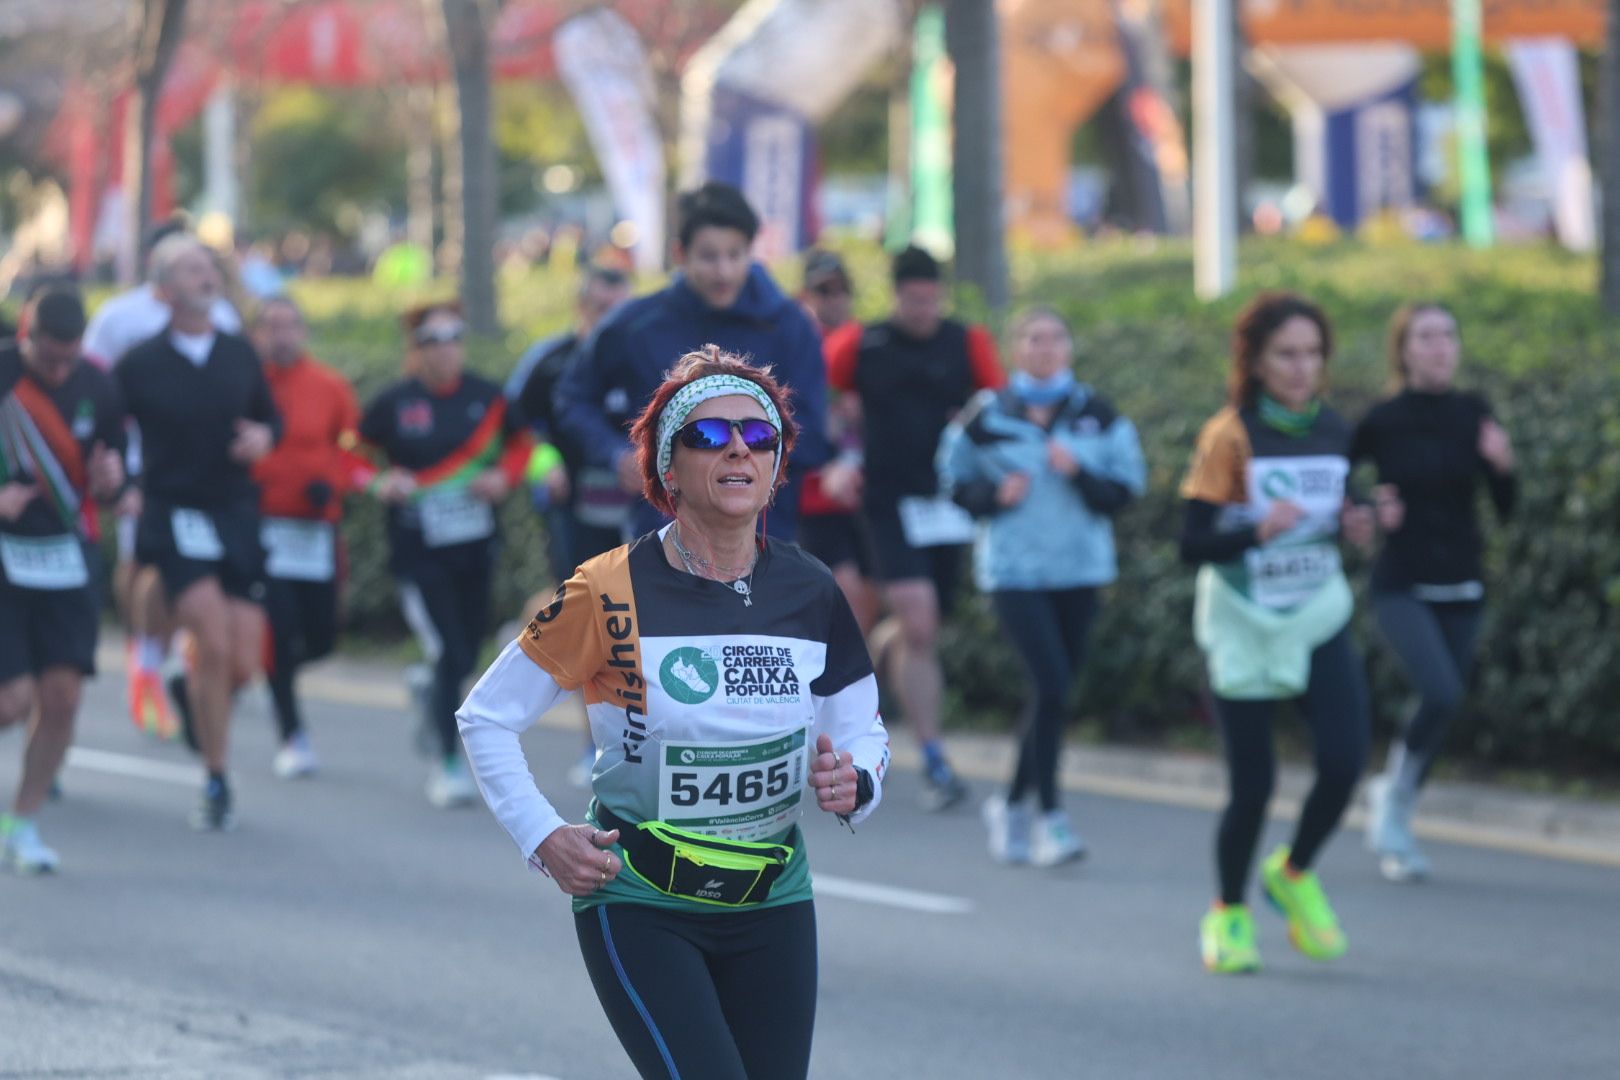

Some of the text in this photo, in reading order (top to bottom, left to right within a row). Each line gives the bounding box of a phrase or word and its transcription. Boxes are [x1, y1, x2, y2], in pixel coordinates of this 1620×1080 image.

[722, 645, 774, 656] CIRCUIT
[775, 647, 793, 658] DE
[722, 656, 795, 668] CARRERES
[724, 667, 799, 685] CAIXA
[724, 683, 800, 697] POPULAR
[726, 697, 752, 705] CIUTAT
[753, 697, 764, 705] DE
[671, 761, 789, 807] 5465
